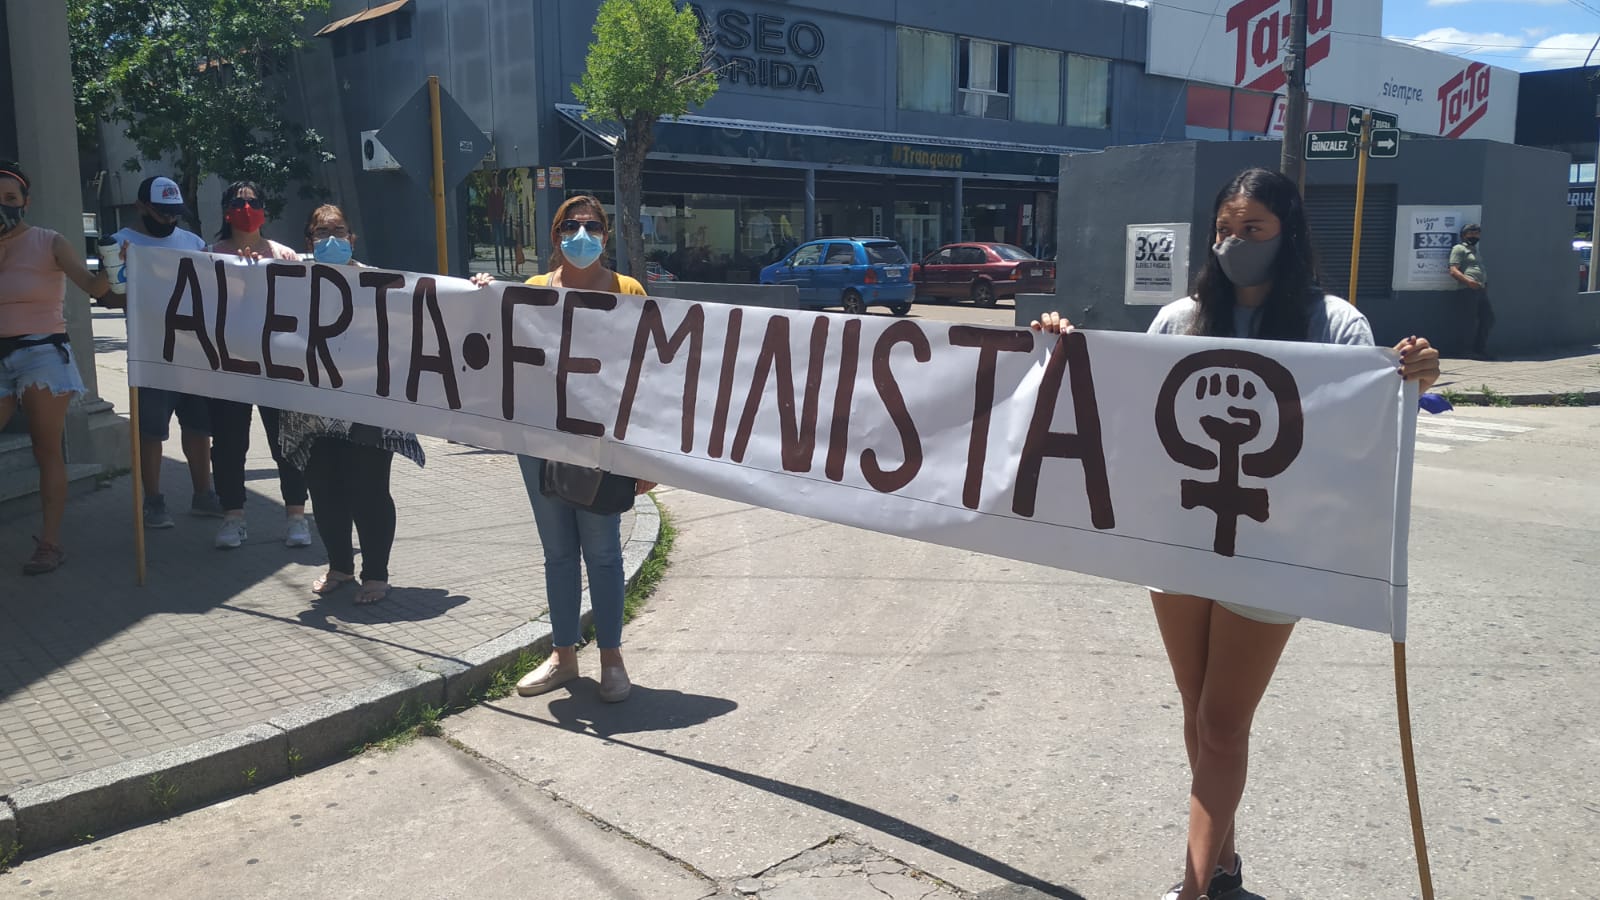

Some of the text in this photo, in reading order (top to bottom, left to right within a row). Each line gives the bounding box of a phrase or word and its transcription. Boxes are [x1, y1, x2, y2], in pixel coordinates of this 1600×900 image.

[1437, 61, 1491, 135] Ta-Ta
[1311, 140, 1347, 152] GONZALEZ
[163, 257, 1116, 530] ALERTA FEMINISTA
